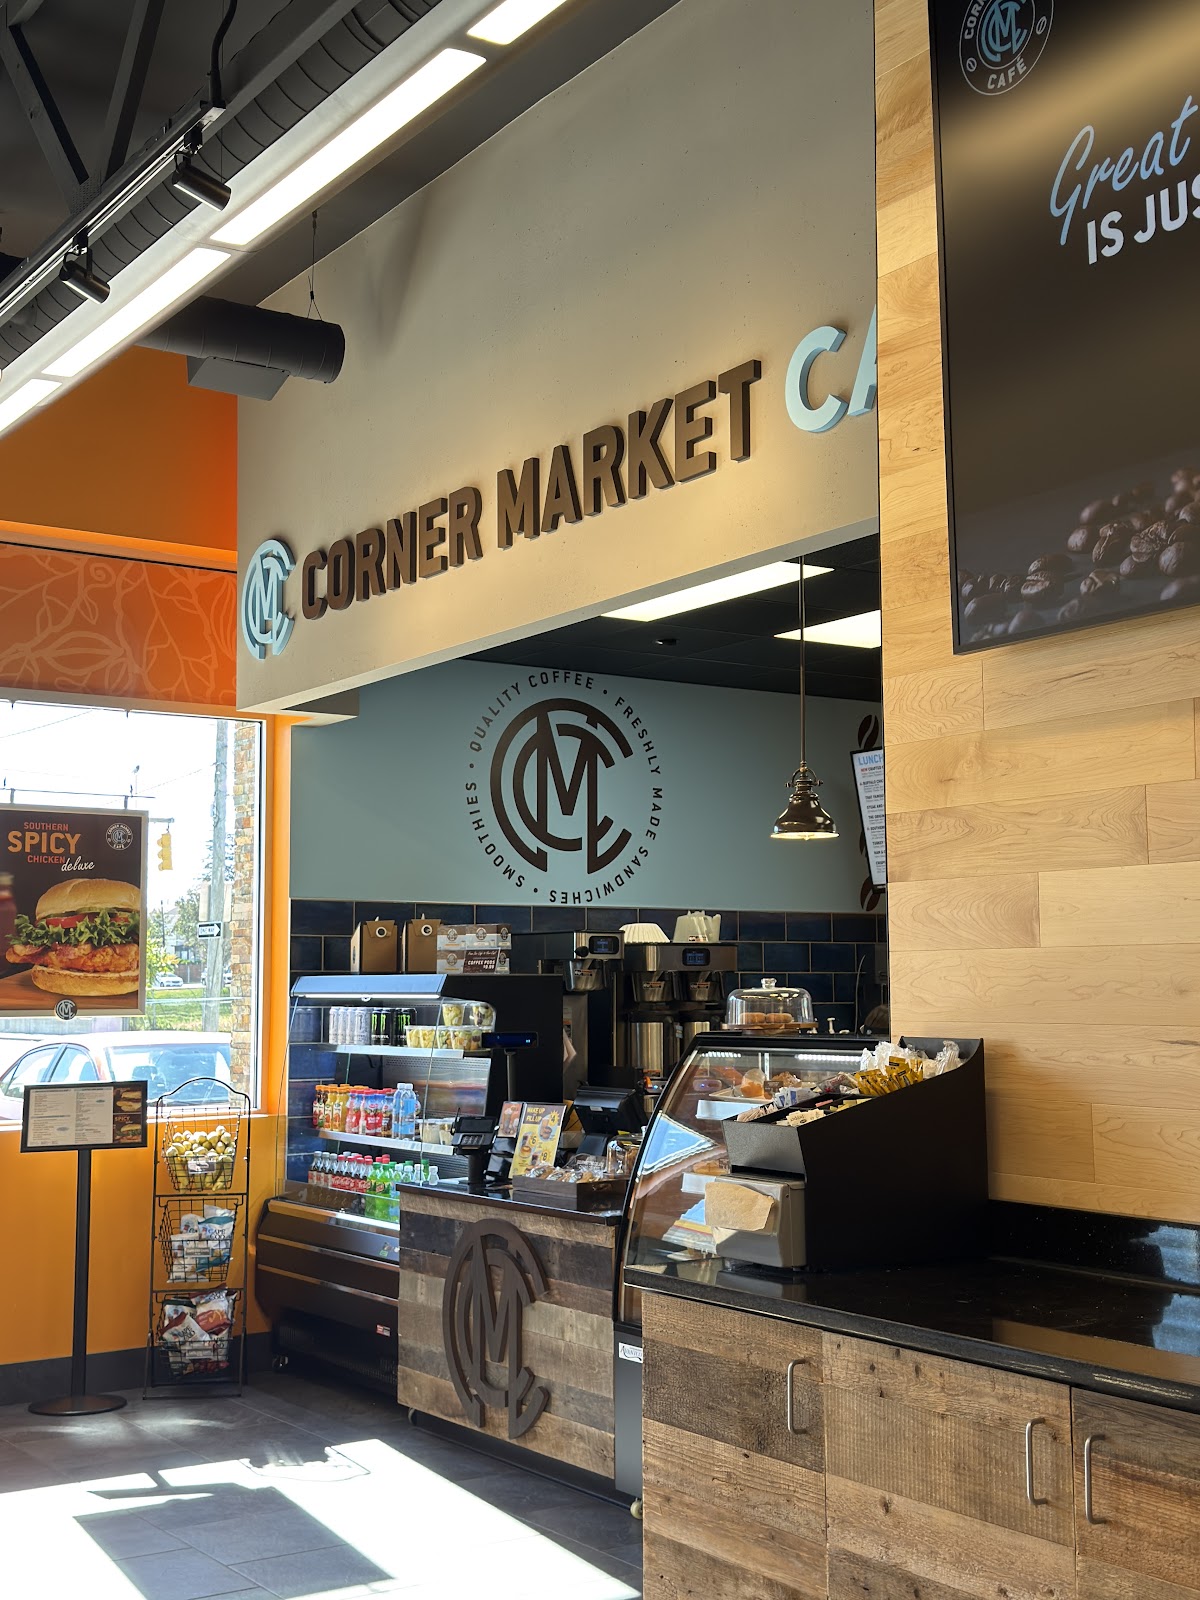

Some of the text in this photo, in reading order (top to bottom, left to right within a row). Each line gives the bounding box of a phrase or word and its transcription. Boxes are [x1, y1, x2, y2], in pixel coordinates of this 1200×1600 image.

[964, 0, 987, 39] COR
[987, 55, 1027, 90] CAFÉ
[1050, 95, 1199, 246] Great
[1087, 210, 1124, 265] IS
[302, 486, 484, 620] CORNER
[497, 359, 762, 551] MARKET
[469, 671, 594, 752] QUALITY COFFEE
[549, 696, 663, 904] FRESHLY MADE SANDWICHES
[7, 831, 82, 854] SPICY
[24, 821, 69, 832] SOUTHERN
[465, 782, 525, 887] SMOOTHIES
[27, 855, 66, 864] CHICKEN
[61, 855, 95, 872] deluxe
